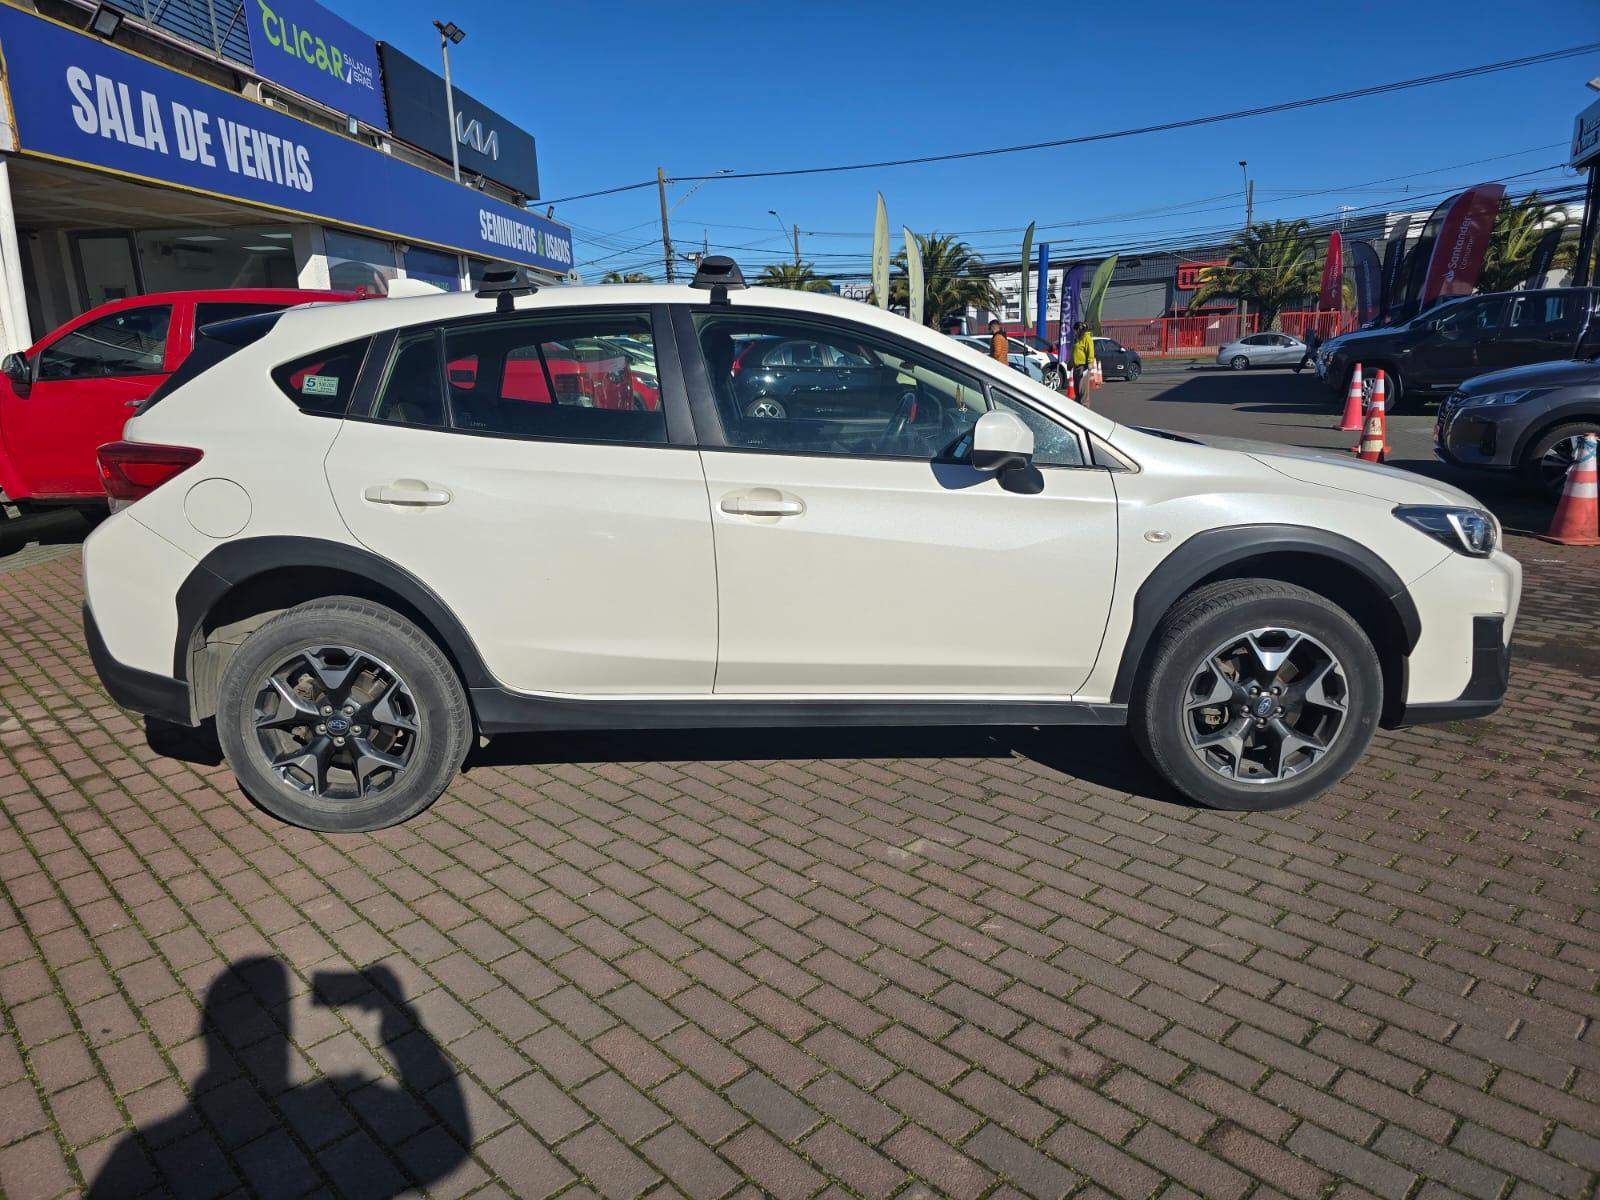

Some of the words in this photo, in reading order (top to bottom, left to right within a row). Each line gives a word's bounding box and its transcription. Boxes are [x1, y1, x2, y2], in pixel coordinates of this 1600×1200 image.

[66, 65, 168, 154] SALA
[171, 101, 216, 167] DE
[217, 117, 313, 192] VENTAS
[456, 111, 499, 161] KIA
[479, 208, 537, 254] SEMINUEVOS
[537, 229, 545, 256] &
[545, 232, 571, 264] USADOS
[1447, 213, 1472, 270] Santander
[1061, 286, 1072, 344] FORUM
[306, 377, 316, 388] 5
